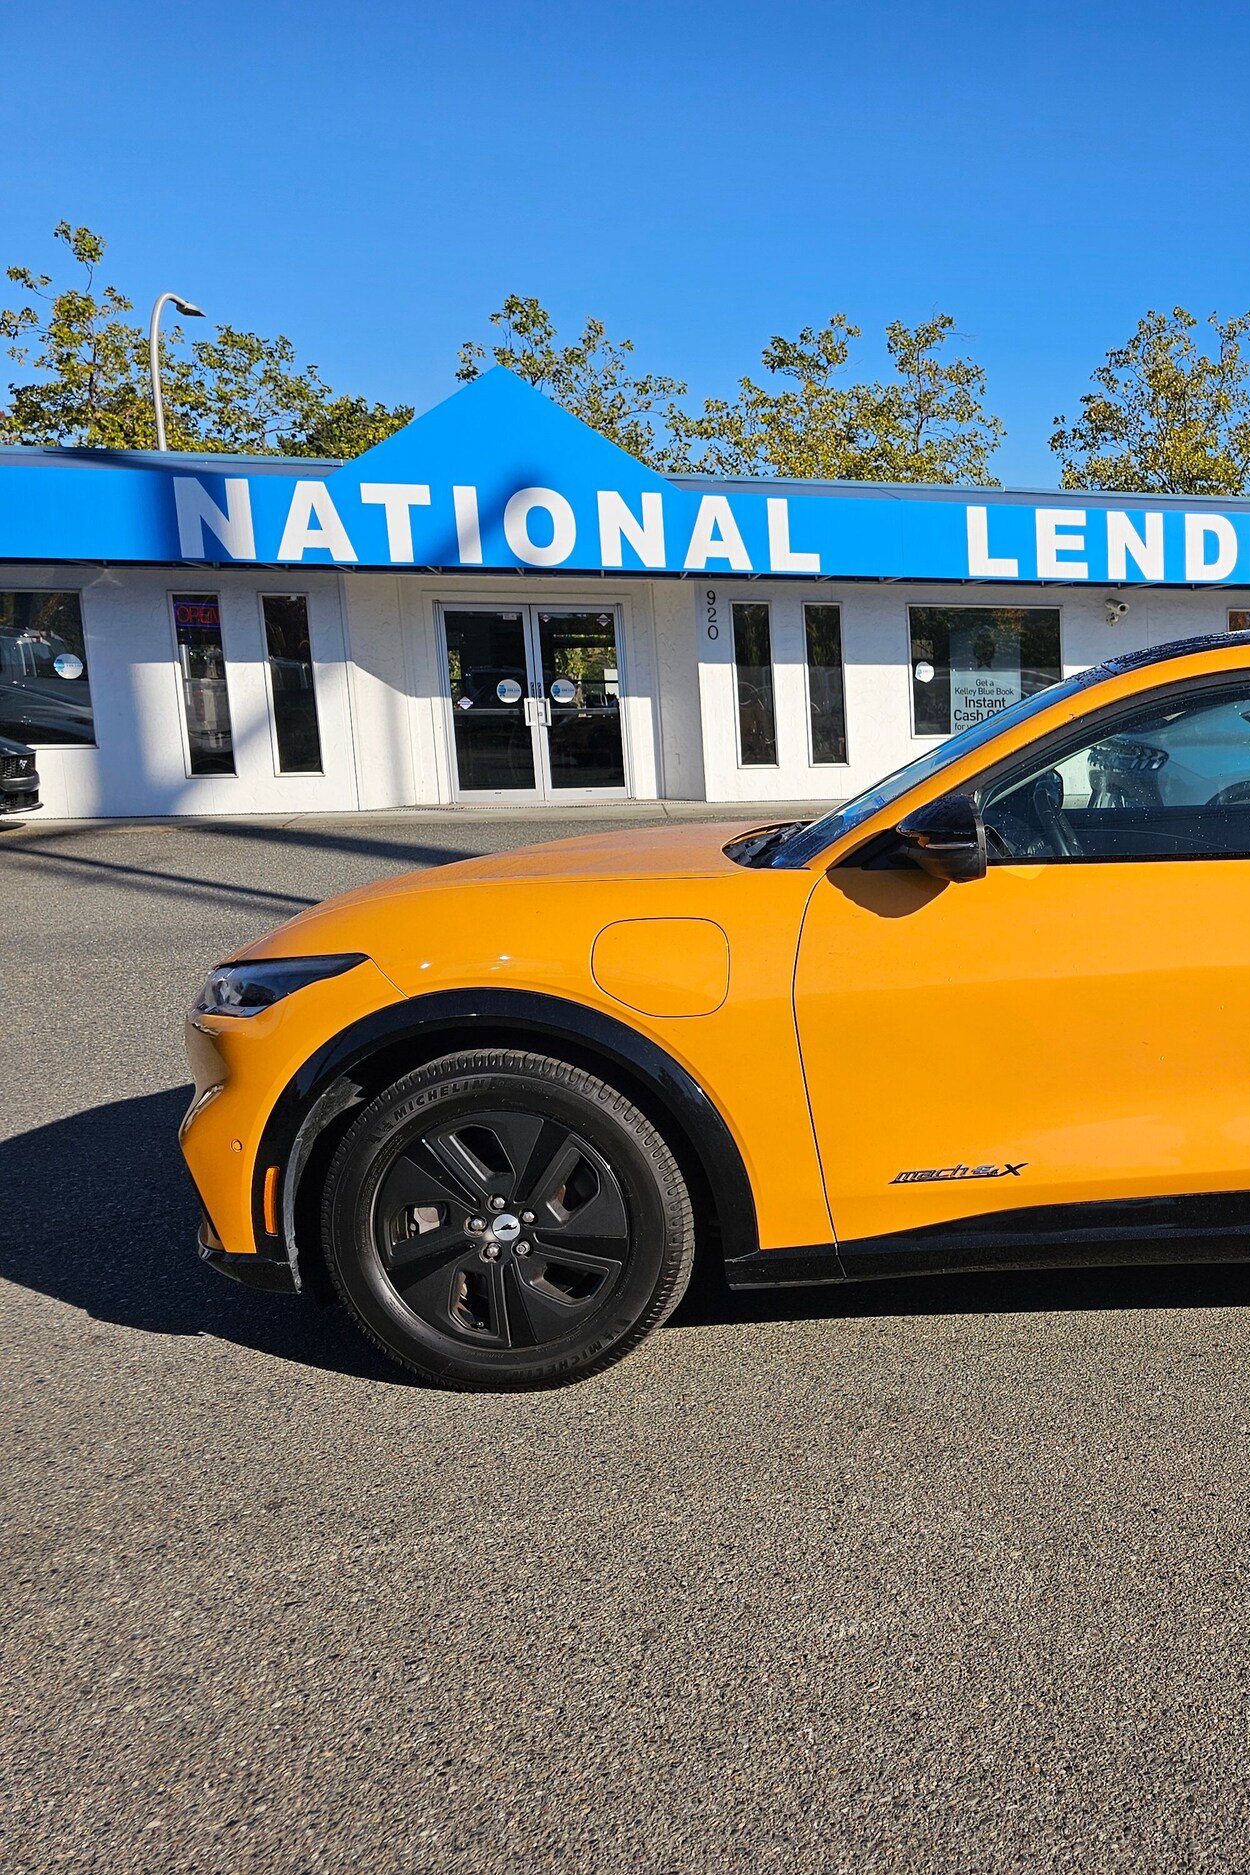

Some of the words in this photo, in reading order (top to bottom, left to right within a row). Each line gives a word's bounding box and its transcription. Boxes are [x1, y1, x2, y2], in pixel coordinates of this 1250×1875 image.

[173, 476, 821, 572] NATIONAL
[706, 590, 719, 640] 920
[975, 678, 988, 687] Get
[954, 688, 977, 696] Kelley
[978, 688, 995, 696] Blue
[996, 688, 1014, 696] Book
[964, 696, 1006, 708] Instant
[953, 709, 982, 721] Cash
[954, 723, 965, 731] for
[392, 1078, 486, 1121] MICHELIN
